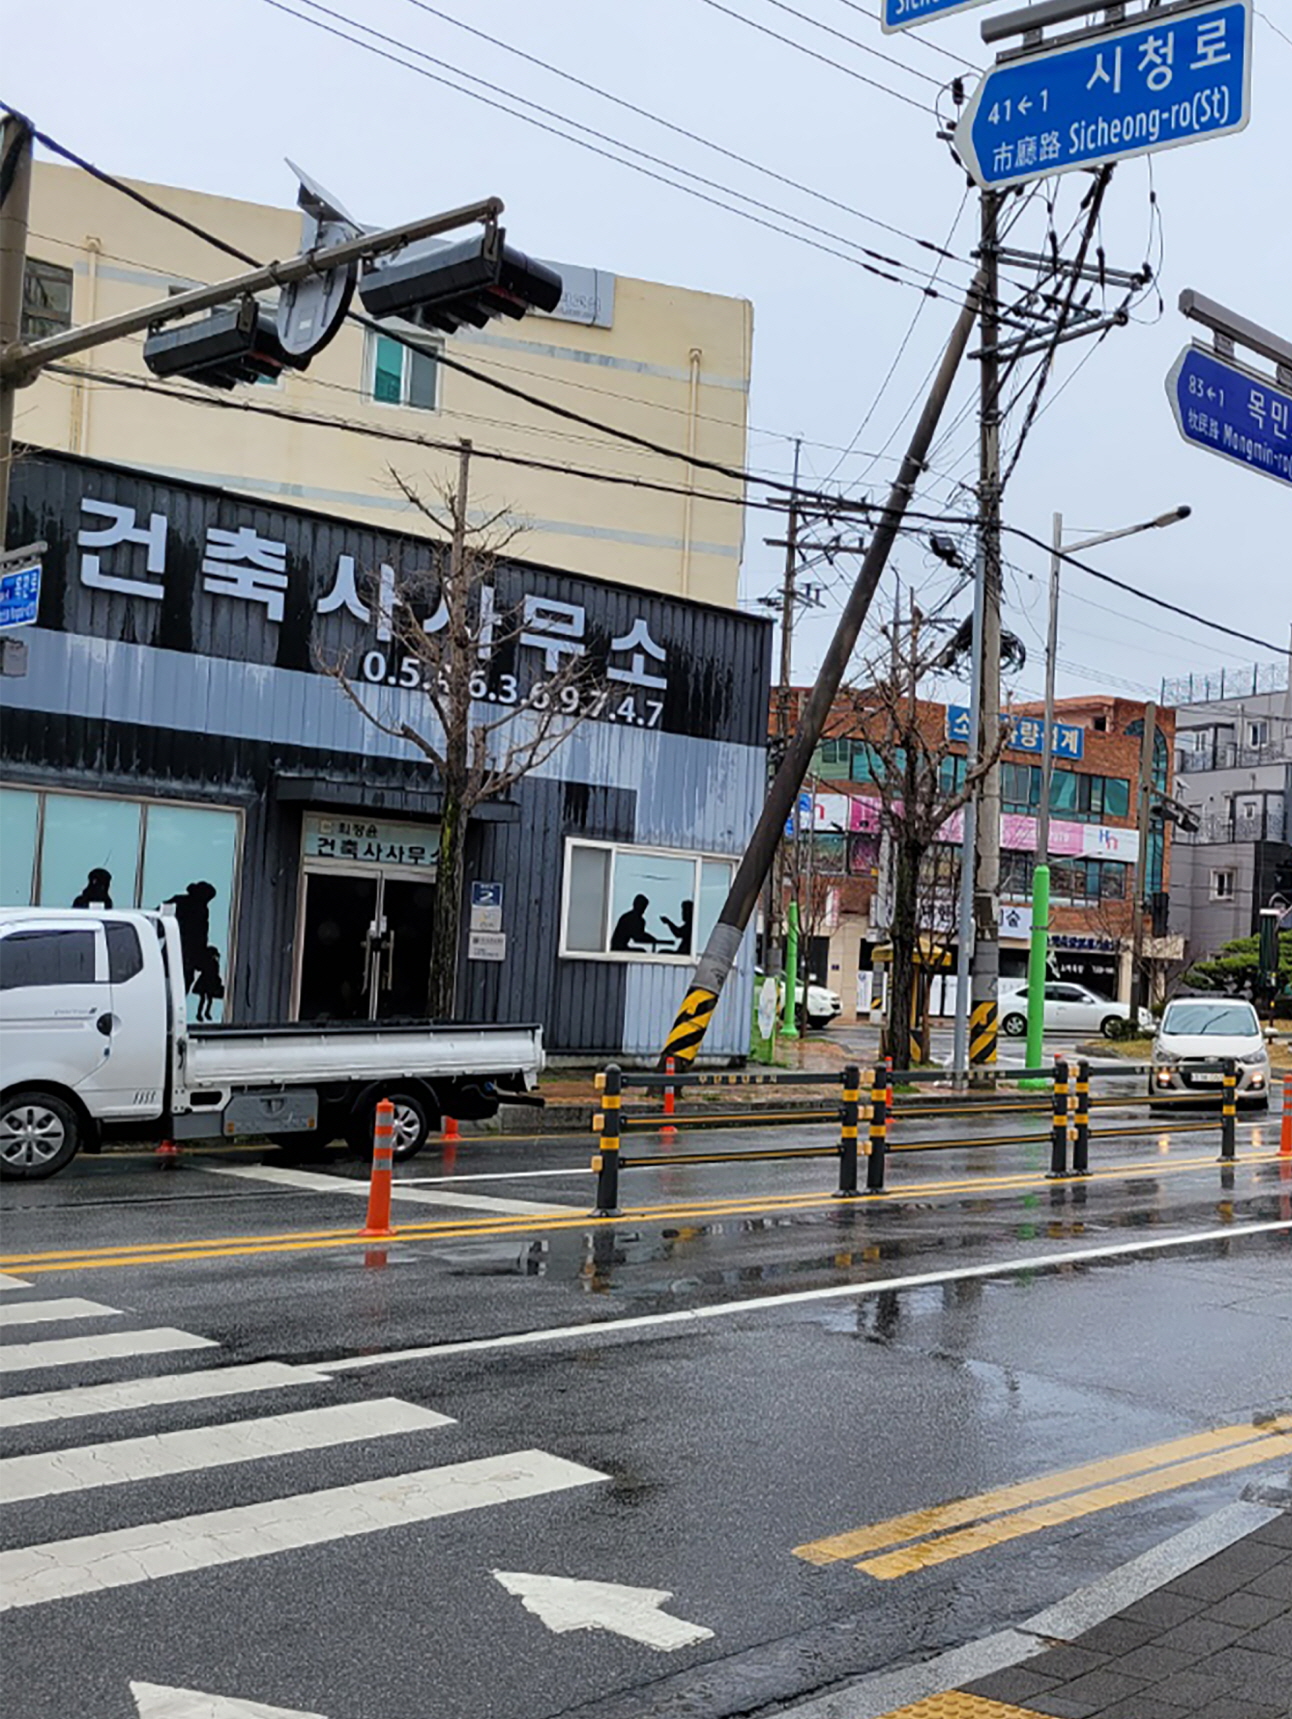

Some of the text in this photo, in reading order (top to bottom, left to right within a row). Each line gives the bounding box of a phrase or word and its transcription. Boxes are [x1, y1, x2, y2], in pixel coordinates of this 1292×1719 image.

[1086, 18, 1231, 94] 시청로
[987, 101, 1013, 126] 41
[993, 85, 1231, 173] 市廳路 Sicheong-ro(St)
[1188, 374, 1205, 397] 83
